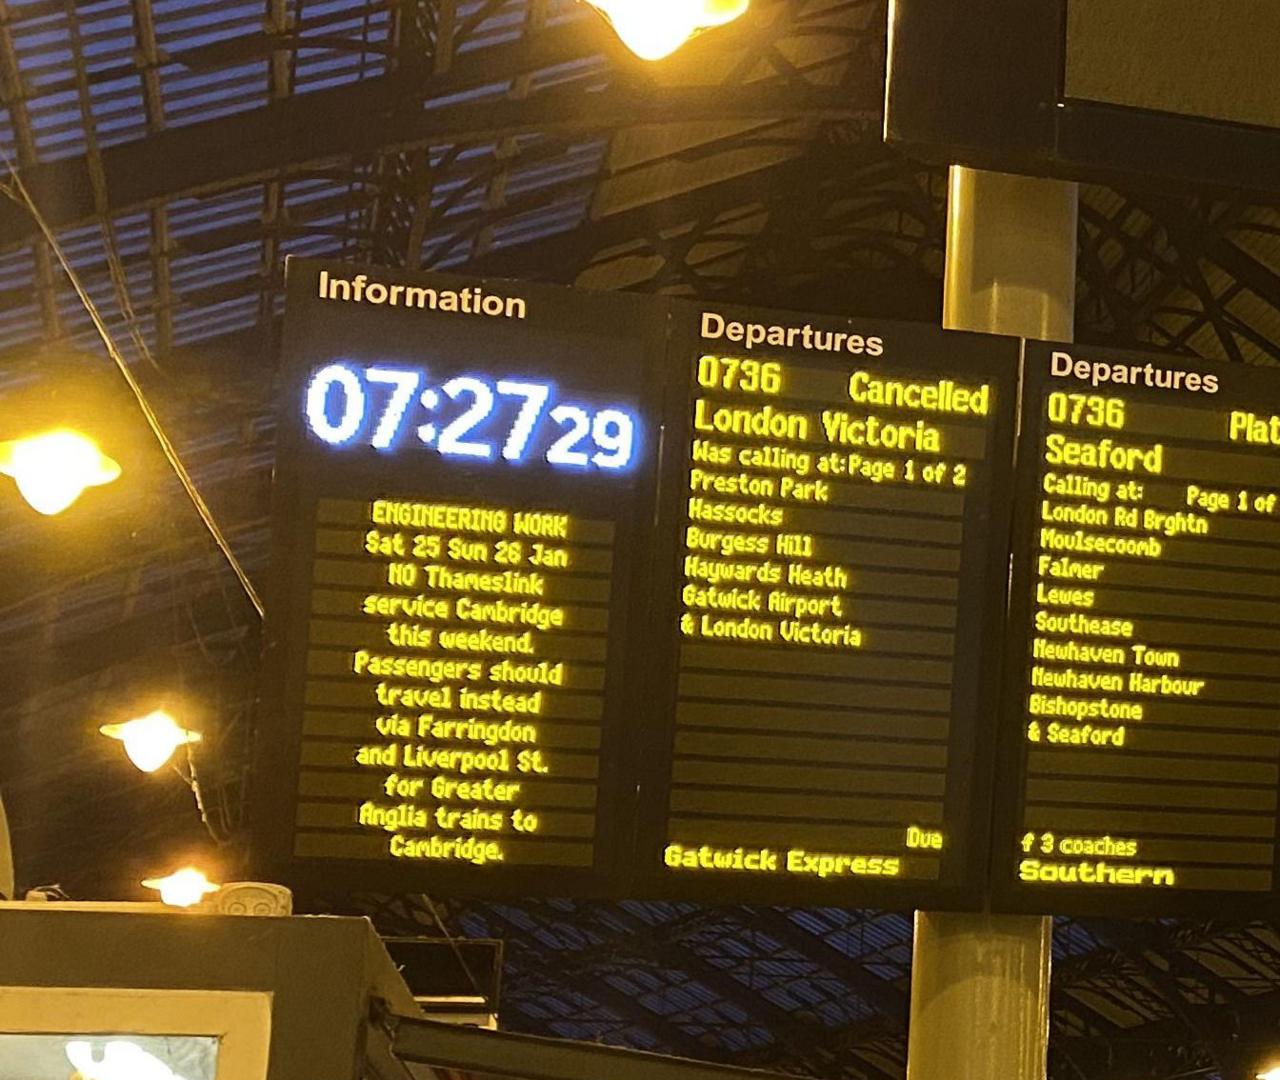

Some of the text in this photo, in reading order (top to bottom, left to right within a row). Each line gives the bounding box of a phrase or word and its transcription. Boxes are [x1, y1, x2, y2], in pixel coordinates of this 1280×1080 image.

[319, 270, 526, 319] Information
[701, 312, 884, 356] Departures
[697, 355, 990, 416] 0736 Cancelled
[1051, 351, 1219, 394] Departures
[694, 399, 941, 453] London Victoria
[1048, 391, 1125, 429] 0736
[1045, 433, 1163, 474] Seaford
[372, 499, 569, 539] ENGINEERING WORK
[364, 530, 569, 568] Sat 25 Sun 26 Jan
[388, 562, 544, 596] NO Thameslink
[684, 555, 848, 590] Haywards Heath
[362, 594, 564, 631] service Cambridge
[386, 622, 534, 654] this weekend.
[353, 650, 564, 686] Passengers should
[905, 826, 943, 850] Due
[664, 844, 900, 878] Gatwick Express
[1019, 859, 1175, 886] Southern
